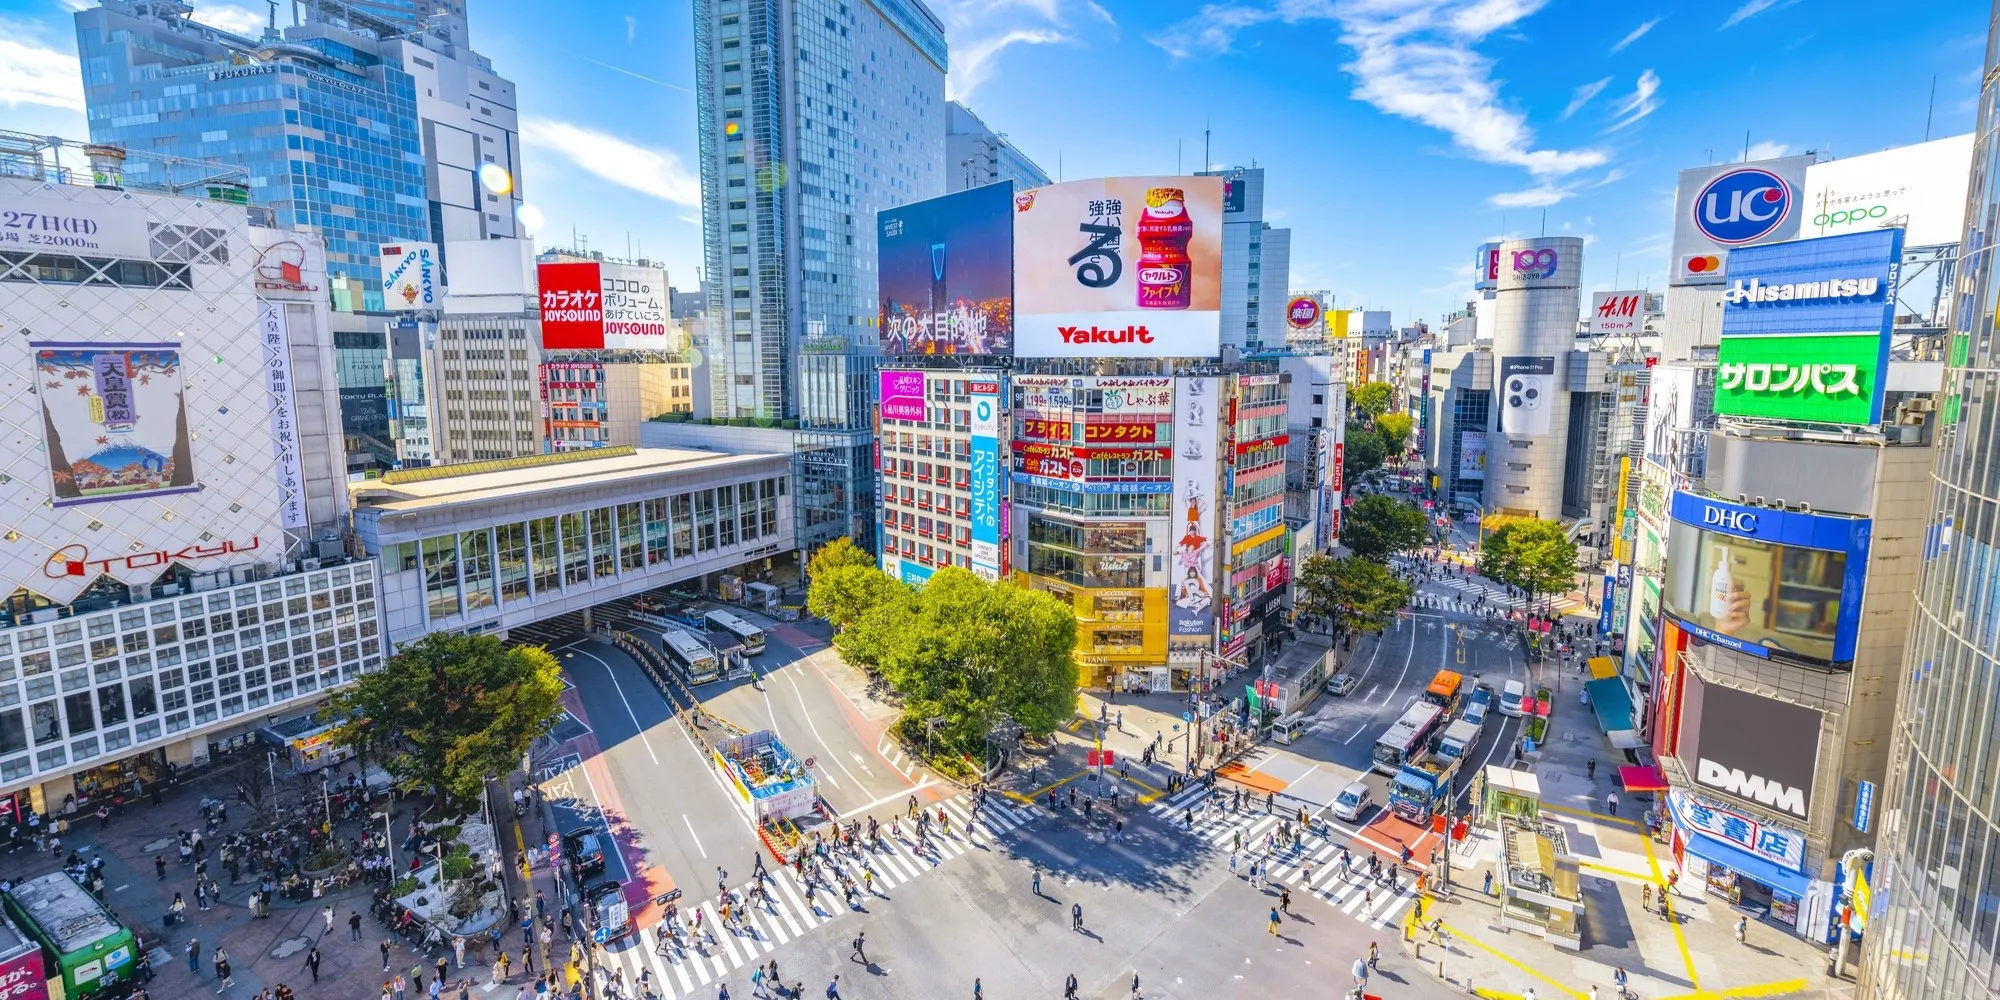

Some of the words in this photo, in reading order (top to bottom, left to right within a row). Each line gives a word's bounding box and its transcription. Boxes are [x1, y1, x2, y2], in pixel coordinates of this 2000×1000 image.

[219, 65, 272, 79] FUKURAS
[306, 71, 337, 86] TOKYU
[1705, 186, 1780, 224] UC
[3, 211, 97, 235] 27日(日)
[1814, 205, 1887, 228] oppo
[0, 231, 19, 242] 場
[384, 251, 417, 289] SANKYO
[1511, 248, 1558, 279] 109
[420, 248, 433, 303] SANKYO
[1145, 272, 1174, 281] ヤクルト
[1512, 273, 1540, 281] SHIBUYA
[603, 278, 650, 294] ココロの
[1143, 284, 1175, 299] ファイブ
[1722, 277, 1878, 305] Hisamitsu
[1886, 262, 1899, 306] サロンパス
[543, 290, 599, 309] カラオケ
[604, 294, 664, 310] ボリューム、
[1598, 295, 1639, 318] H&M
[544, 310, 601, 322] JOYSOUND
[605, 309, 665, 321] あげていこう。
[605, 322, 665, 336] JOYSOUND
[1058, 326, 1155, 344] Yakult
[1096, 379, 1170, 387] しゃぶしゃぶバイキング
[1720, 363, 1859, 395] サロンパス
[1015, 393, 1024, 401] 9F
[1127, 391, 1170, 406] しゃぶ葉
[1086, 426, 1153, 439] コンタクト
[799, 455, 824, 463] MARK
[828, 456, 849, 464] CITY
[1051, 446, 1075, 460] ガスト
[1132, 449, 1164, 461] ガスト
[1015, 457, 1024, 467] 7F
[1039, 458, 1067, 475] ガスト
[974, 449, 985, 526] アイシティ
[986, 451, 995, 528] コンタクトの
[1112, 484, 1171, 492] 英会話イーオン
[1704, 505, 1757, 532] DHC
[87, 537, 259, 573] TOKYU
[1265, 595, 1281, 614] LUSH
[1179, 619, 1204, 627] Rakuten
[1695, 627, 1711, 638] DHC
[1711, 633, 1742, 649] Channel
[1697, 757, 1806, 816] DMM
